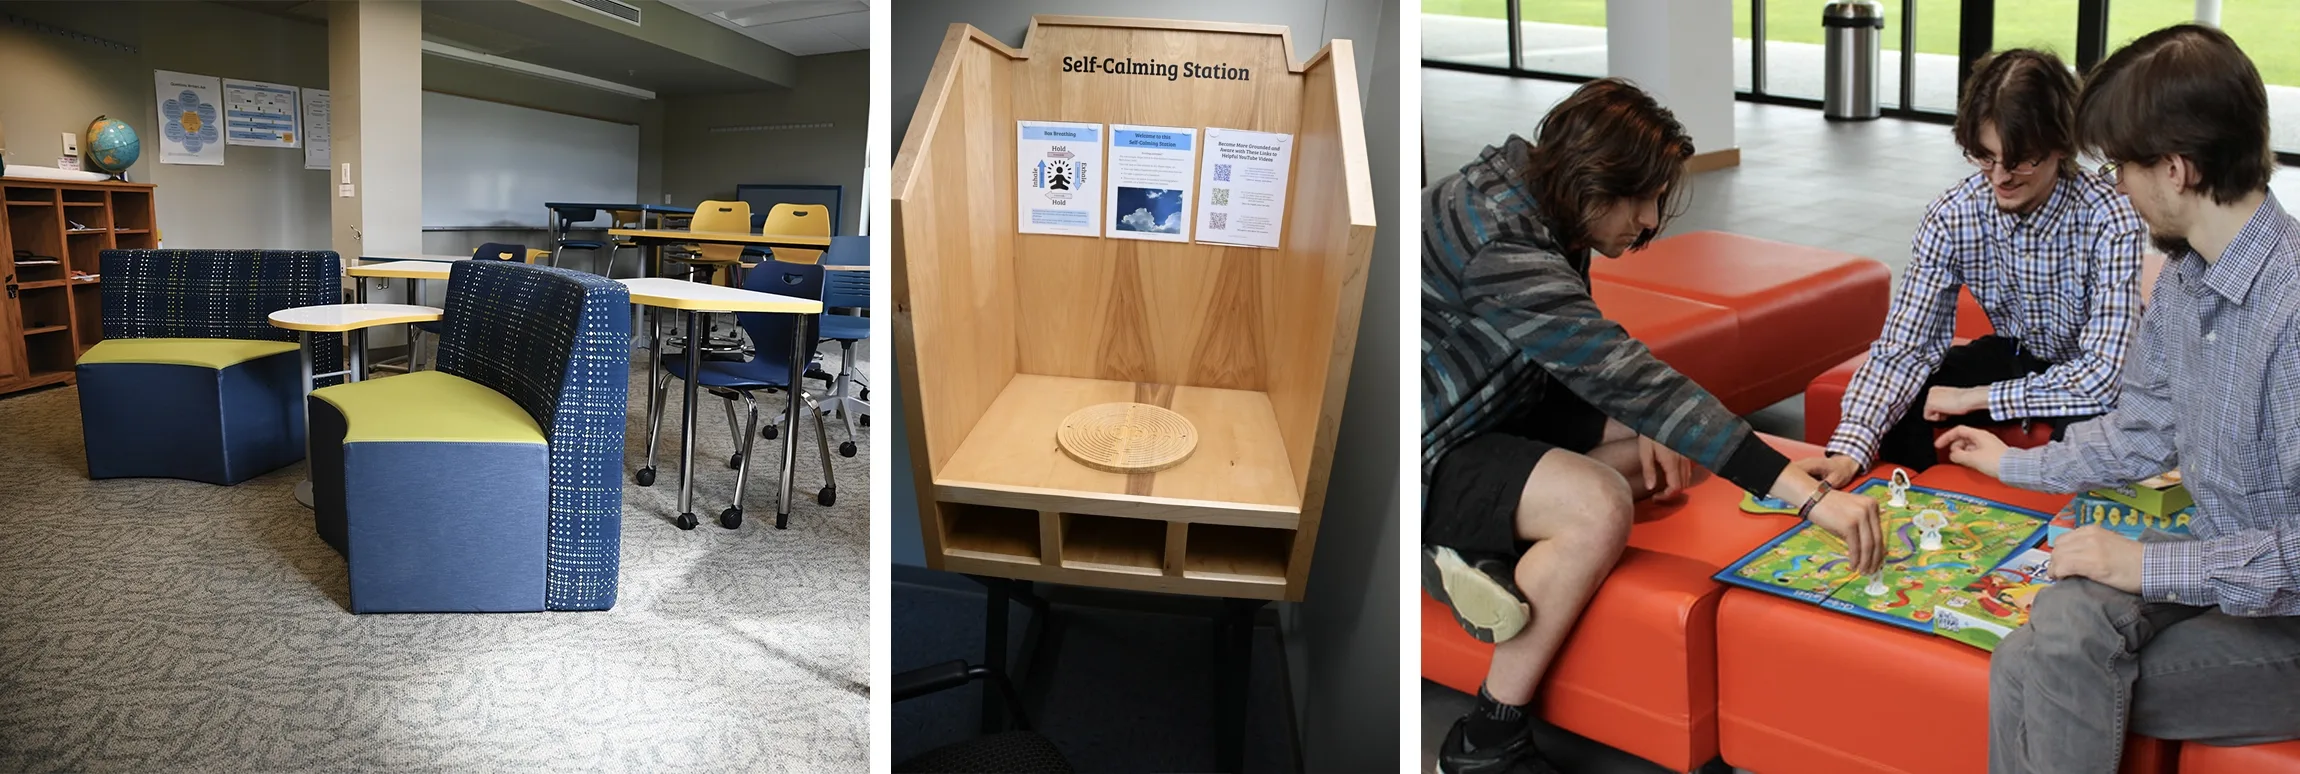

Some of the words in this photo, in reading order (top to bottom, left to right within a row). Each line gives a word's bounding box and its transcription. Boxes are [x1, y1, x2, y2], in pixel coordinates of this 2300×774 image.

[1062, 56, 1178, 81] Self-Calming
[1183, 61, 1250, 81] Station
[1053, 130, 1077, 138] Breathing
[1129, 139, 1158, 147] Self-Calming
